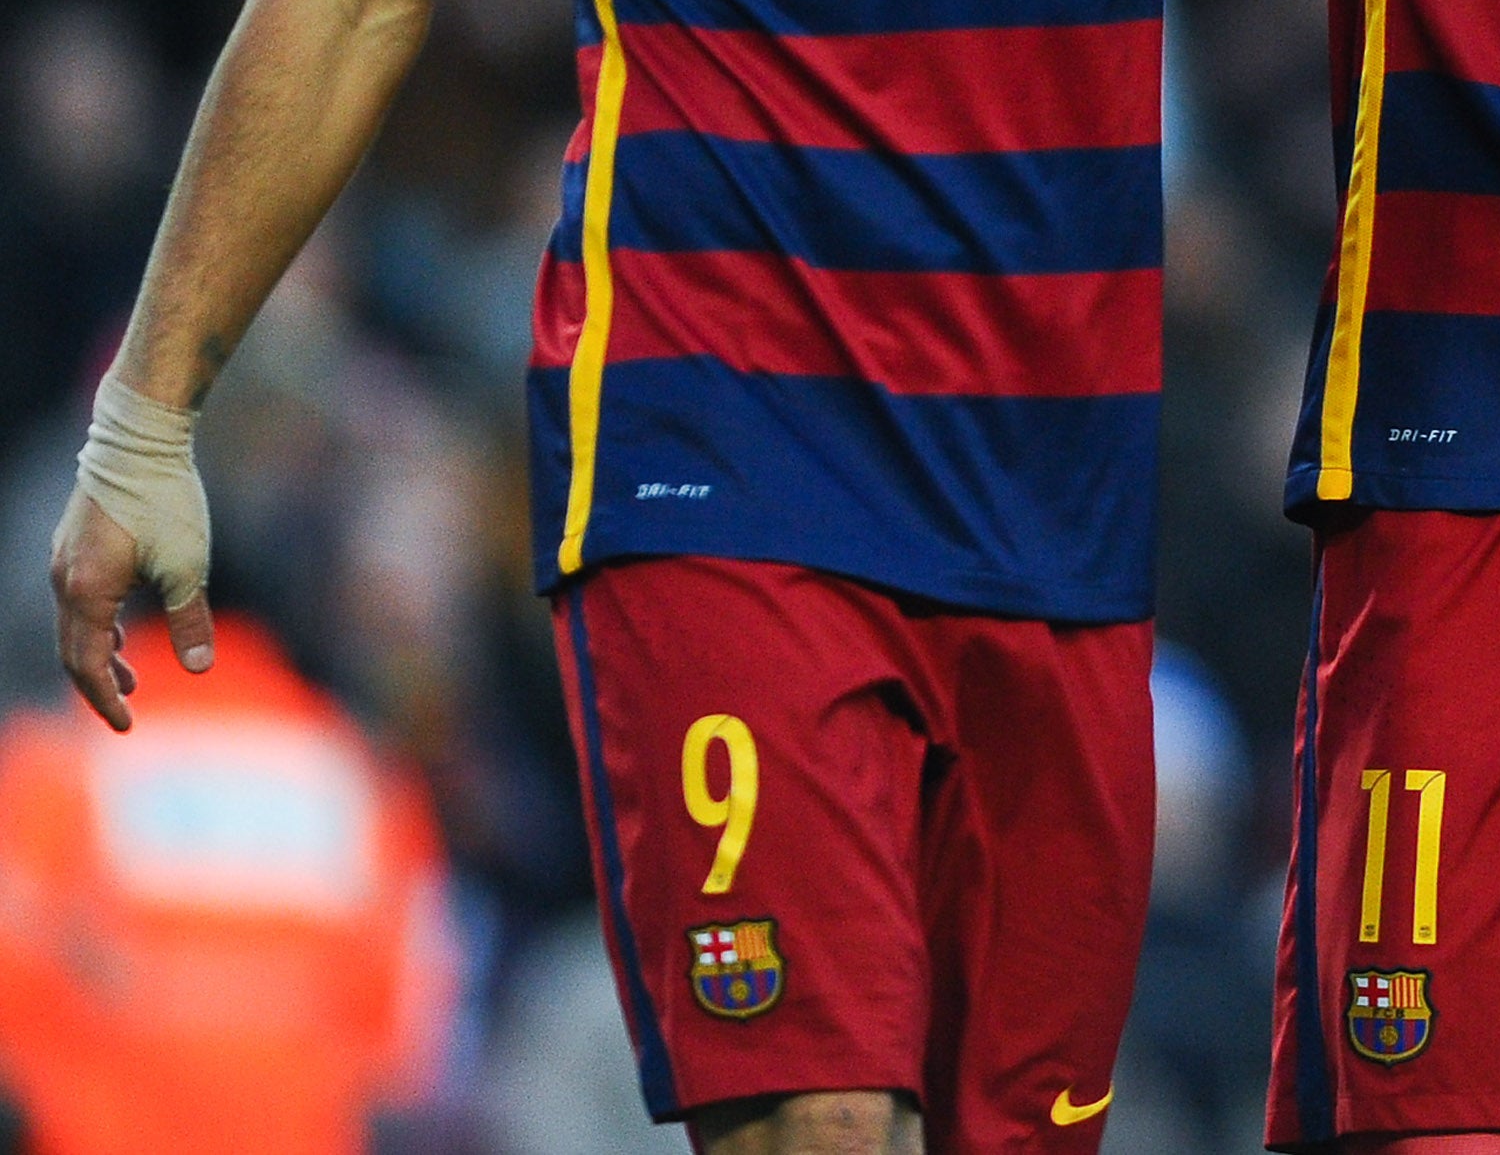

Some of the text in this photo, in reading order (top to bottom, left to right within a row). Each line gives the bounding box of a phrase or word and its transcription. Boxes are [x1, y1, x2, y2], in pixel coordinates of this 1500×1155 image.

[1388, 428, 1458, 443] DRI-FIT
[681, 713, 760, 895] 9
[1359, 768, 1447, 945] 11
